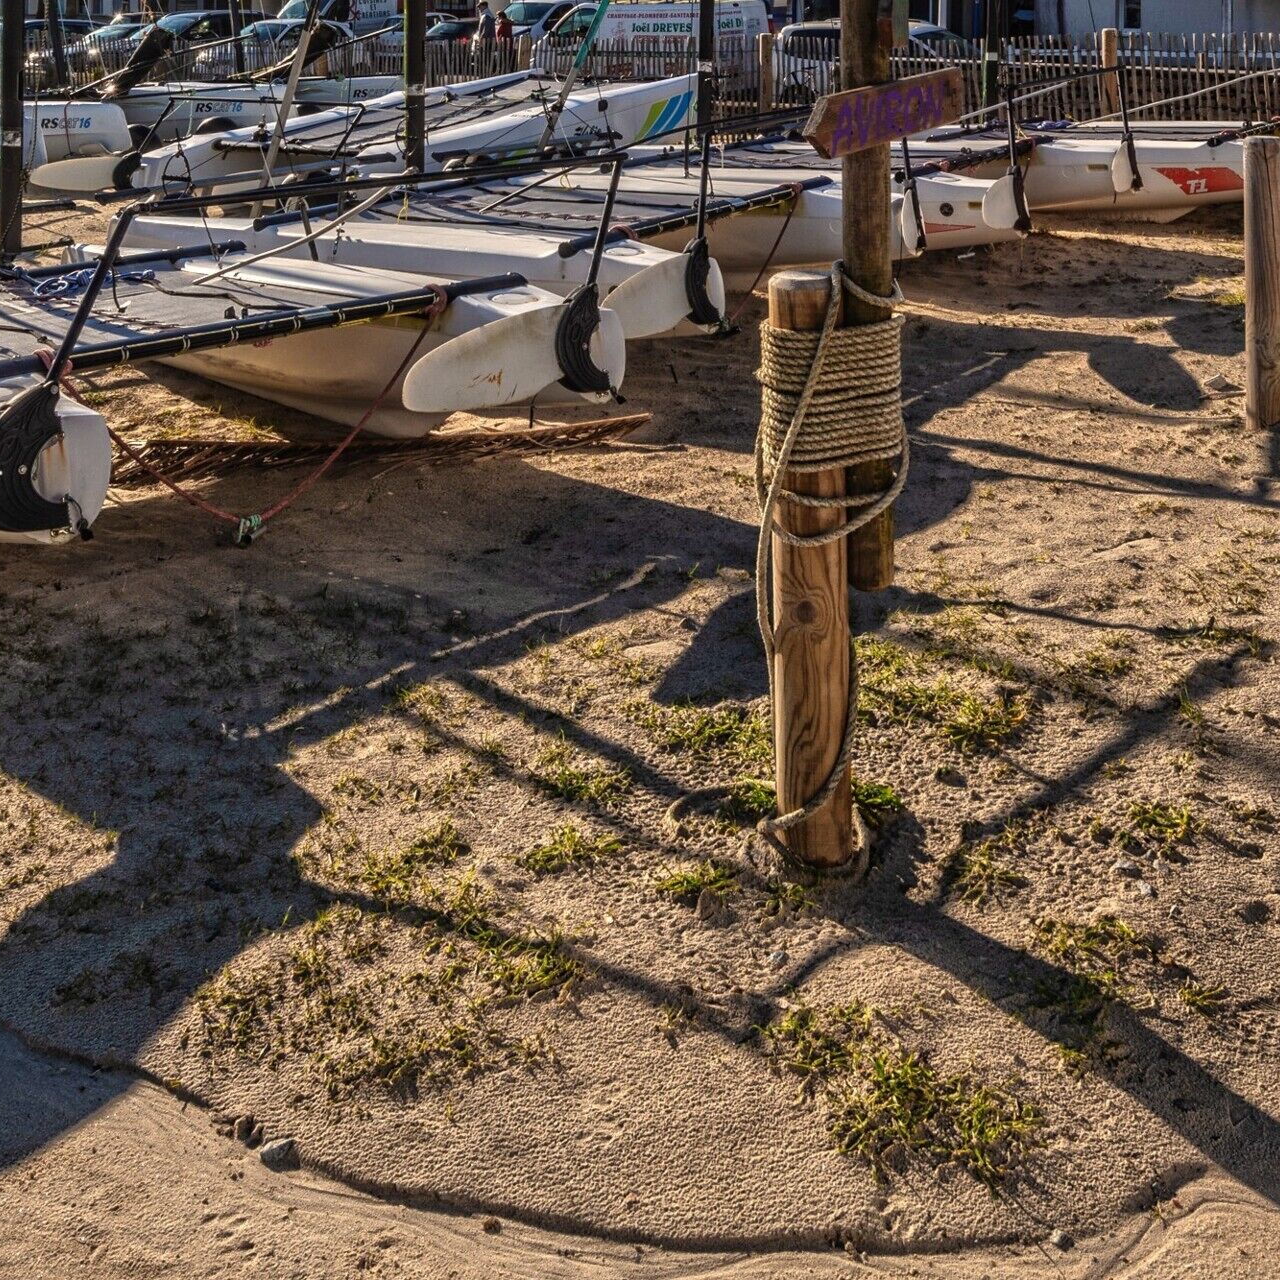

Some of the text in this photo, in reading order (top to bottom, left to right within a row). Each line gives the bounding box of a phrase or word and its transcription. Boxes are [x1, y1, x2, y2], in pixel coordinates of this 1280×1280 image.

[632, 22, 692, 33] Joël DREVES
[832, 79, 945, 157] AVIRON
